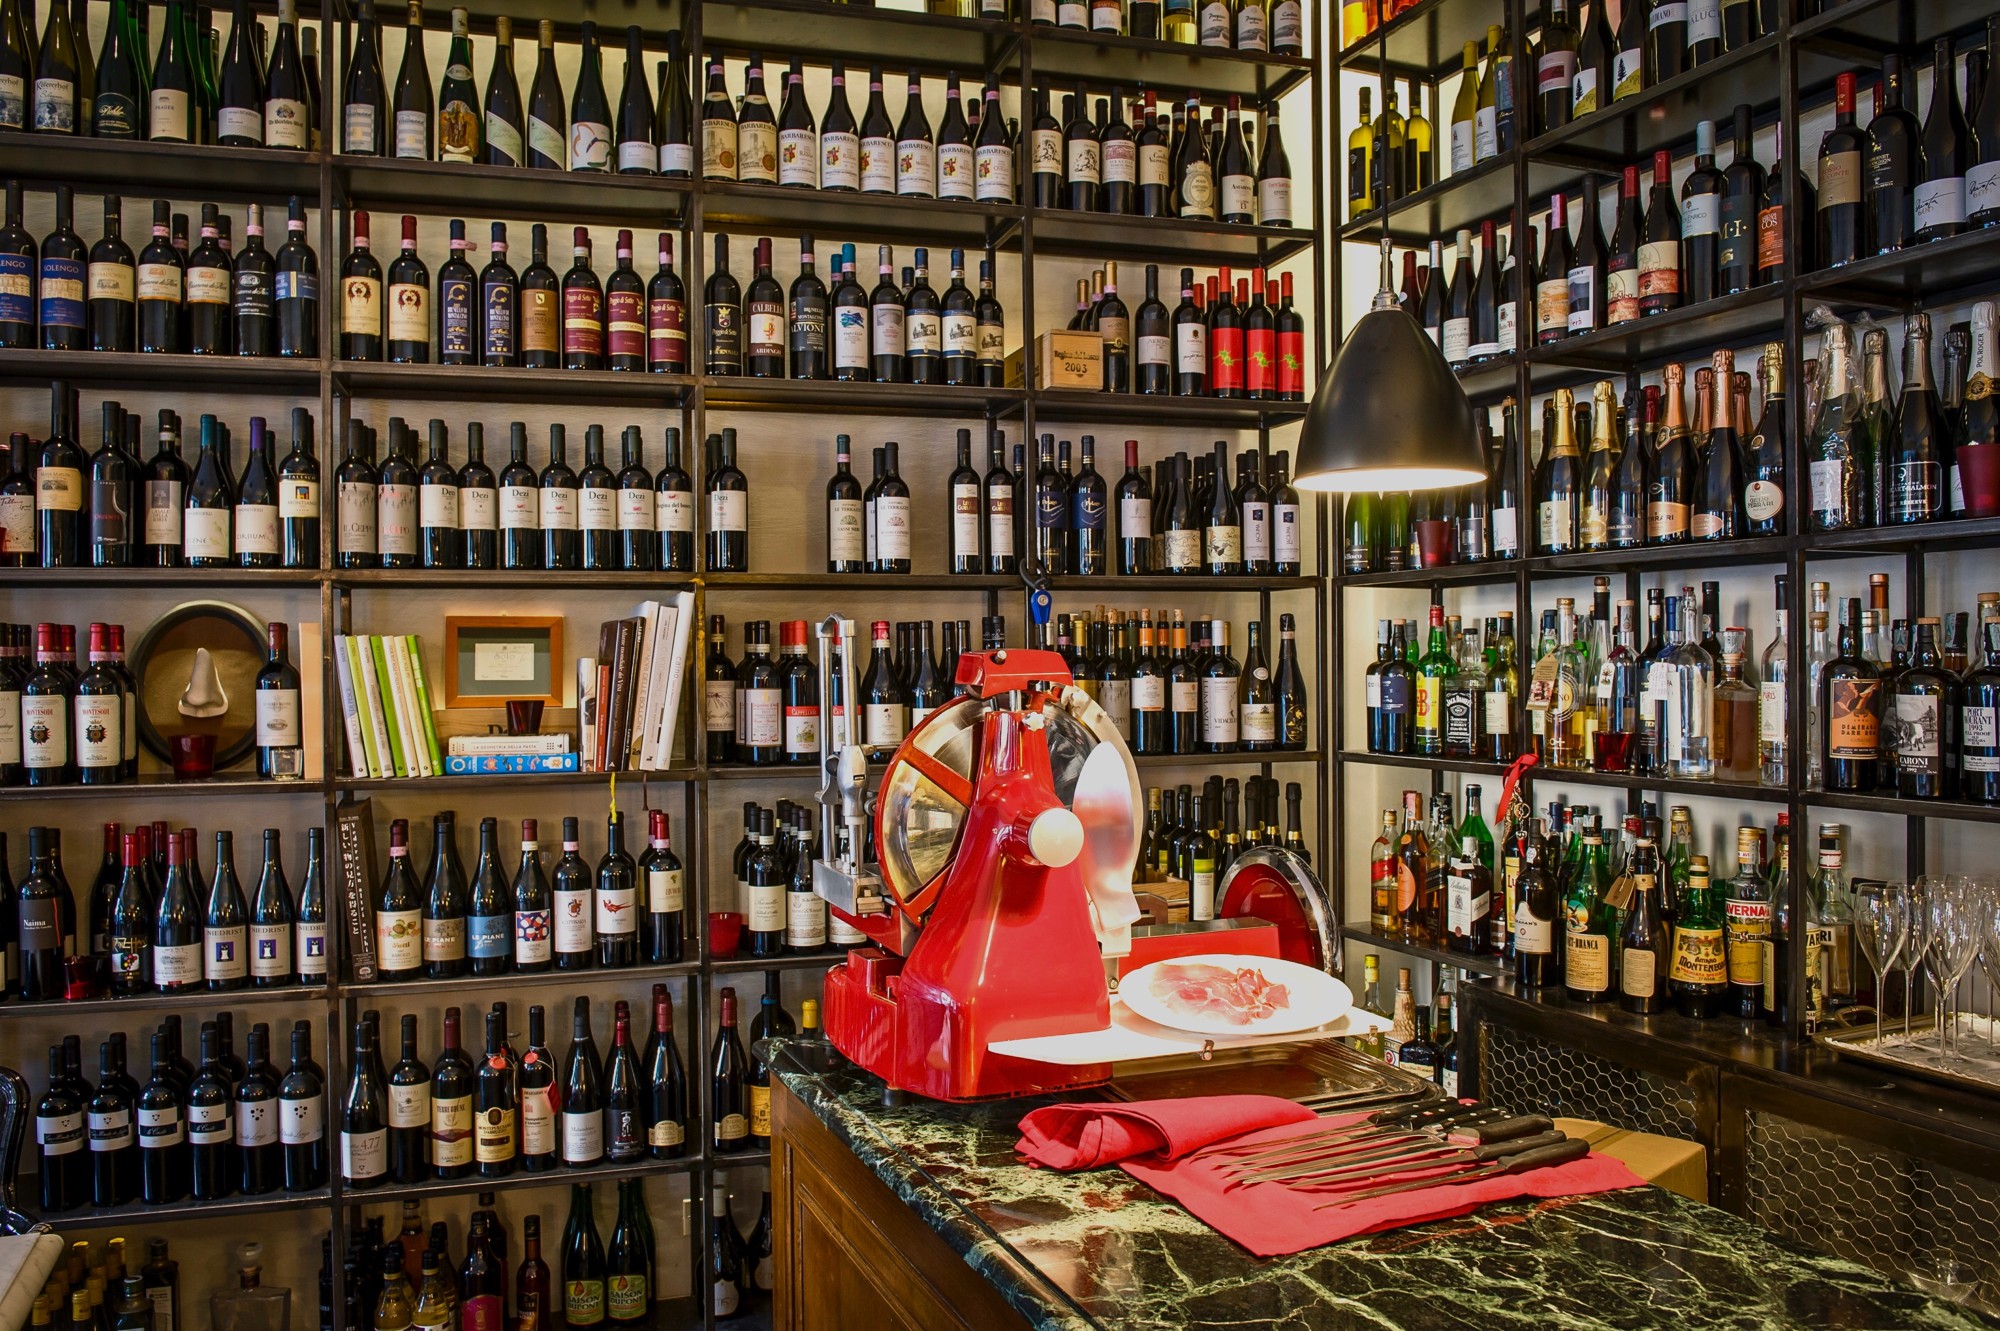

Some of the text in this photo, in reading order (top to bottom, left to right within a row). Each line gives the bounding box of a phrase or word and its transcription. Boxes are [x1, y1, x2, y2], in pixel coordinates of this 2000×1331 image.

[702, 119, 735, 130] ARBARESCO
[740, 122, 776, 132] BARBARESCO
[780, 133, 816, 143] BARBARESCO
[823, 134, 859, 144] BARBARESCO
[976, 147, 1011, 157] BARBARESCO
[1762, 219, 1777, 230] COS
[44, 261, 79, 273] SOLENGO
[1975, 333, 1984, 368] POL ROGER
[1064, 362, 1088, 374] 2003
[472, 491, 489, 499] Dezi
[511, 489, 529, 497] Dezi
[550, 490, 568, 499] Dezi
[588, 491, 608, 500] Dezi
[628, 491, 645, 500] Dezi
[713, 493, 728, 501] Dezi
[1967, 708, 1984, 717] PORT
[1968, 724, 1984, 732] 1993
[1899, 756, 1928, 766] CARONI
[1726, 903, 1764, 918] AVERNA
[23, 919, 46, 927] Naima
[206, 928, 244, 937] NIEDRIST
[251, 926, 287, 934] NIEDRIST
[609, 1289, 643, 1299] SAISON
[567, 1295, 600, 1304] SAISON
[609, 1296, 643, 1305] DUPONT
[566, 1301, 600, 1310] DUPONT
